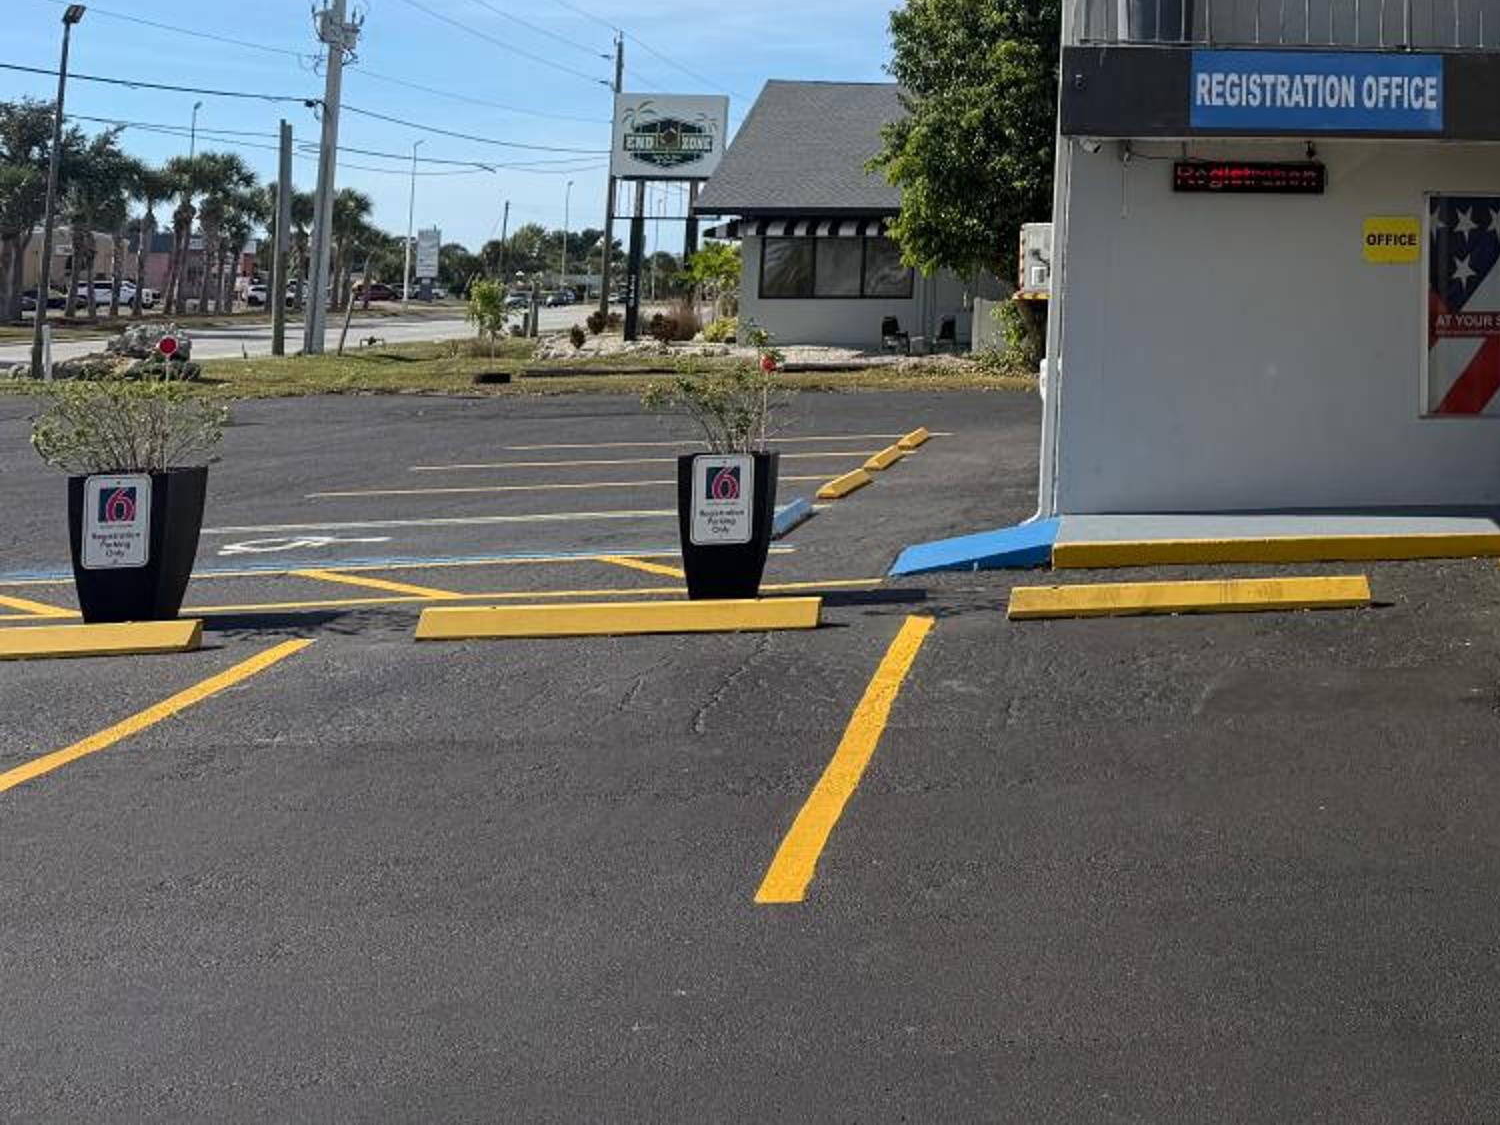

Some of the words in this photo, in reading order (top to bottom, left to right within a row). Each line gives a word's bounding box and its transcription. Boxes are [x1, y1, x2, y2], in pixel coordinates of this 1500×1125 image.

[1195, 72, 1355, 108] REGISTRATION
[1361, 75, 1438, 110] OFFICE
[625, 135, 655, 150] END
[680, 135, 711, 150] ZONE
[1366, 233, 1418, 246] OFFICE
[1437, 314, 1453, 327] AT
[1455, 314, 1493, 327] YOUR
